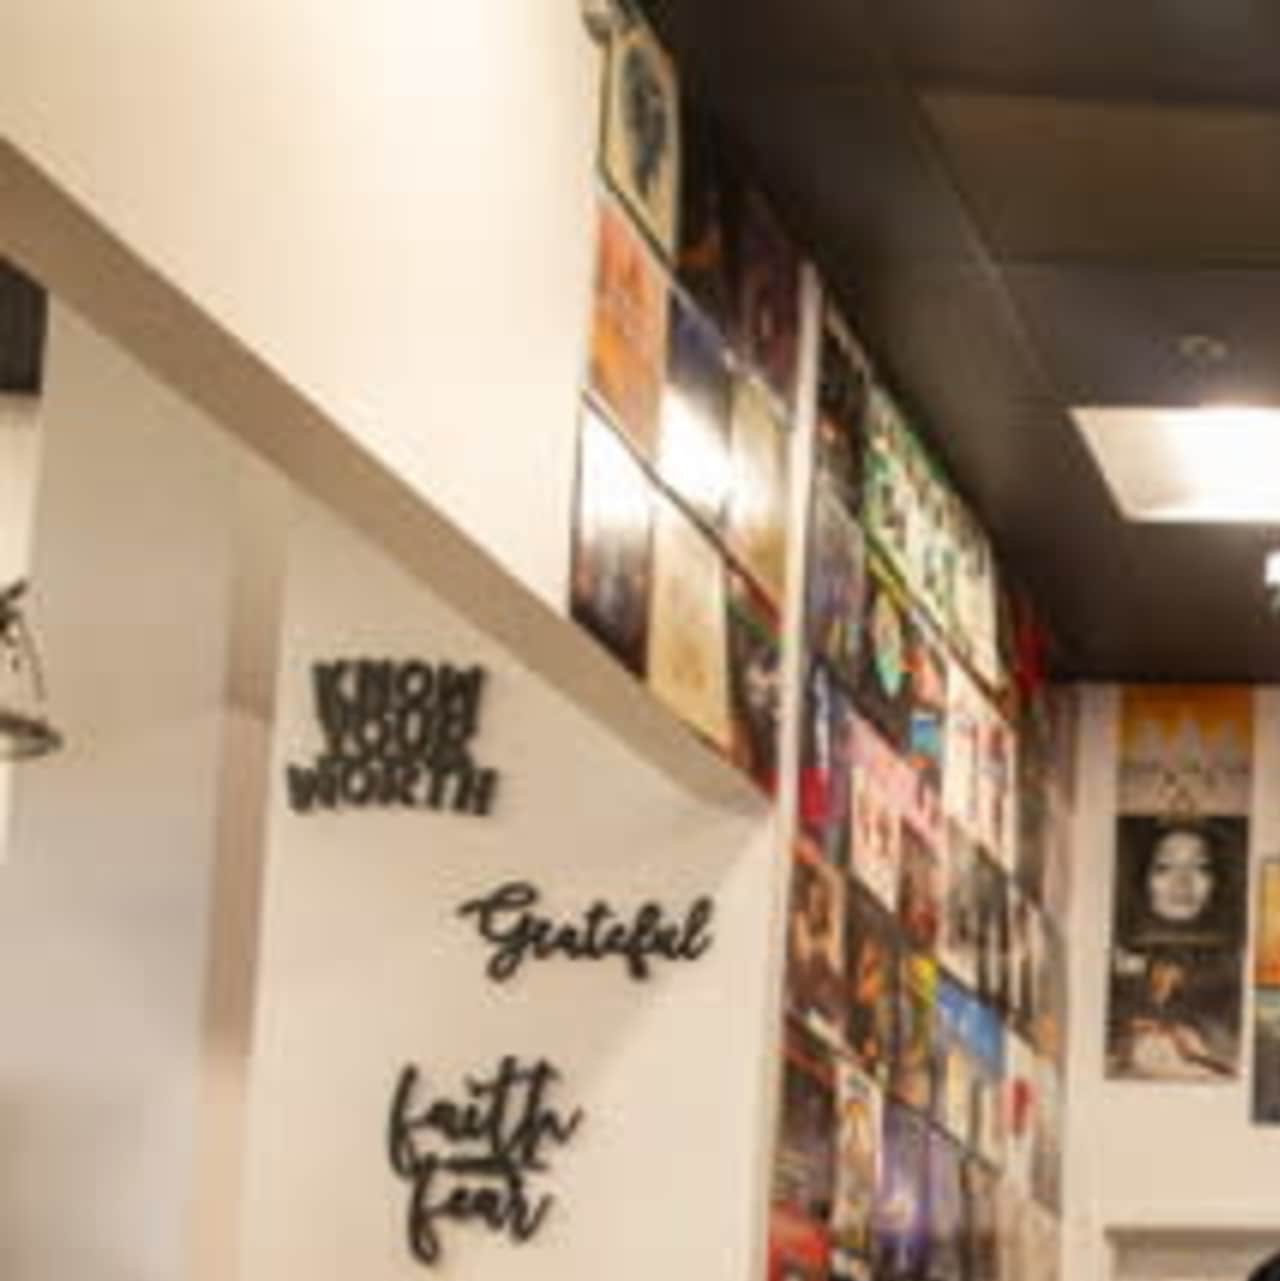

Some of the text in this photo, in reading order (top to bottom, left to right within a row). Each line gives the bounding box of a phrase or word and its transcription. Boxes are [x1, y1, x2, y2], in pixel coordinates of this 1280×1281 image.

[312, 658, 487, 708] KNOW
[318, 703, 476, 764] YOUR
[287, 757, 500, 817] WORTH
[457, 881, 713, 981] Grateful
[388, 1055, 582, 1177] faith
[407, 1150, 556, 1267] fear
